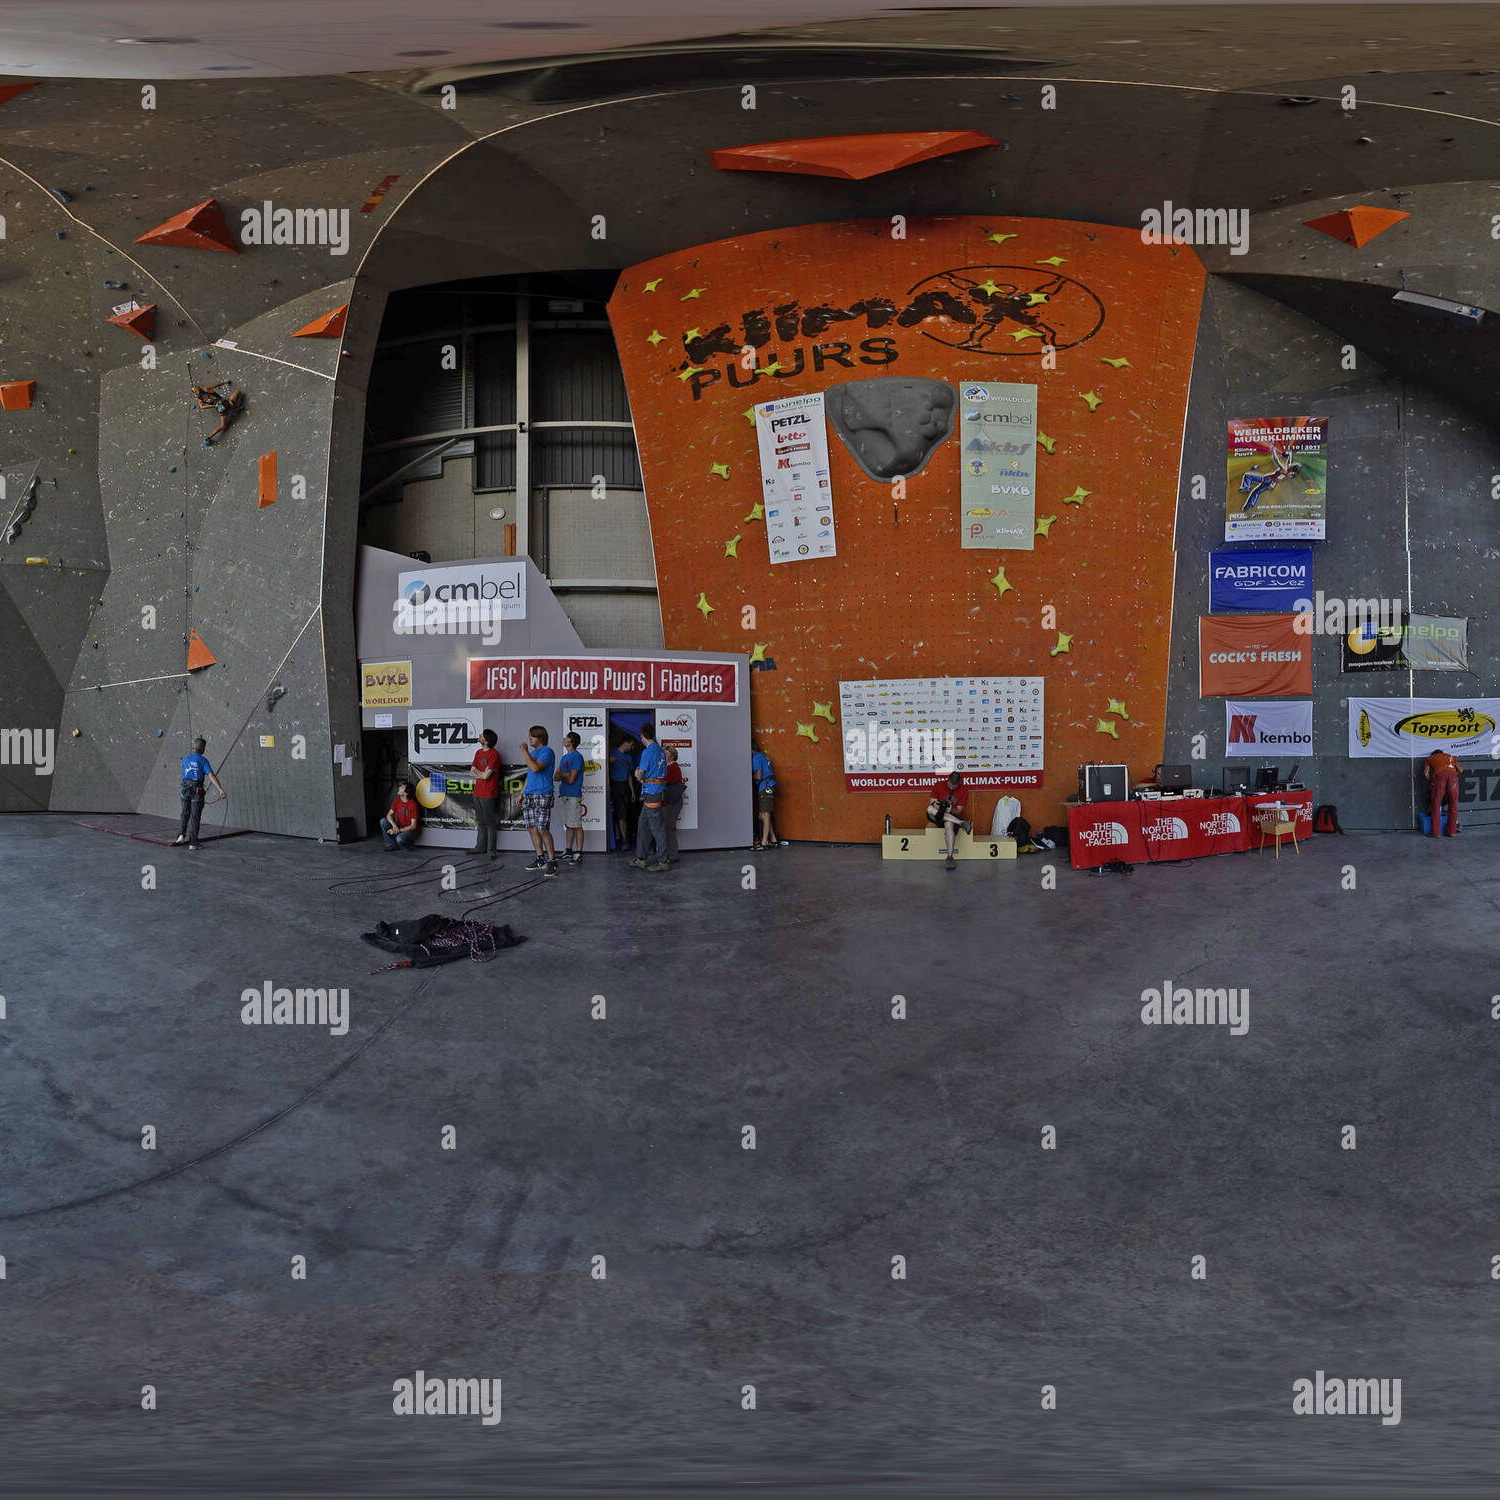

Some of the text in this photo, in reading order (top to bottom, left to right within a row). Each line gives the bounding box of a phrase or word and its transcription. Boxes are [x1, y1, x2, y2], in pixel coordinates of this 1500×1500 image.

[772, 414, 811, 433] PETZL
[983, 412, 1032, 425] cmbel
[1234, 426, 1321, 437] WERELDBEKER
[1234, 433, 1321, 444] MUURKLIMMEN
[991, 484, 1032, 496] BVKB
[1215, 565, 1306, 579] FABRICOM
[435, 572, 520, 603] cmbel
[1378, 623, 1460, 639] sunelpo
[1209, 650, 1302, 664] COCK'S FRESH
[365, 672, 409, 688] BVKB
[486, 666, 723, 694] IFSC Worldcup Puurs Flanders
[365, 696, 409, 705] WORLDCUP
[569, 716, 603, 731] PETZL
[1411, 721, 1481, 736] Topsport
[414, 722, 479, 755] PETZL
[1260, 731, 1311, 744] kembo
[850, 778, 905, 787] WORLDCUP
[963, 775, 1037, 786] KLIMAX-PUURS
[1155, 817, 1173, 826] THE
[1212, 812, 1227, 822] THE
[1093, 822, 1112, 832] THE
[1141, 825, 1173, 835] NORTH
[1200, 820, 1227, 830] NORTH
[1079, 830, 1112, 840] NORTH
[1150, 832, 1173, 842] FACE
[1207, 827, 1227, 837] FACE
[900, 837, 909, 851] 2
[1088, 837, 1112, 847] FACE
[989, 843, 998, 857] 3
